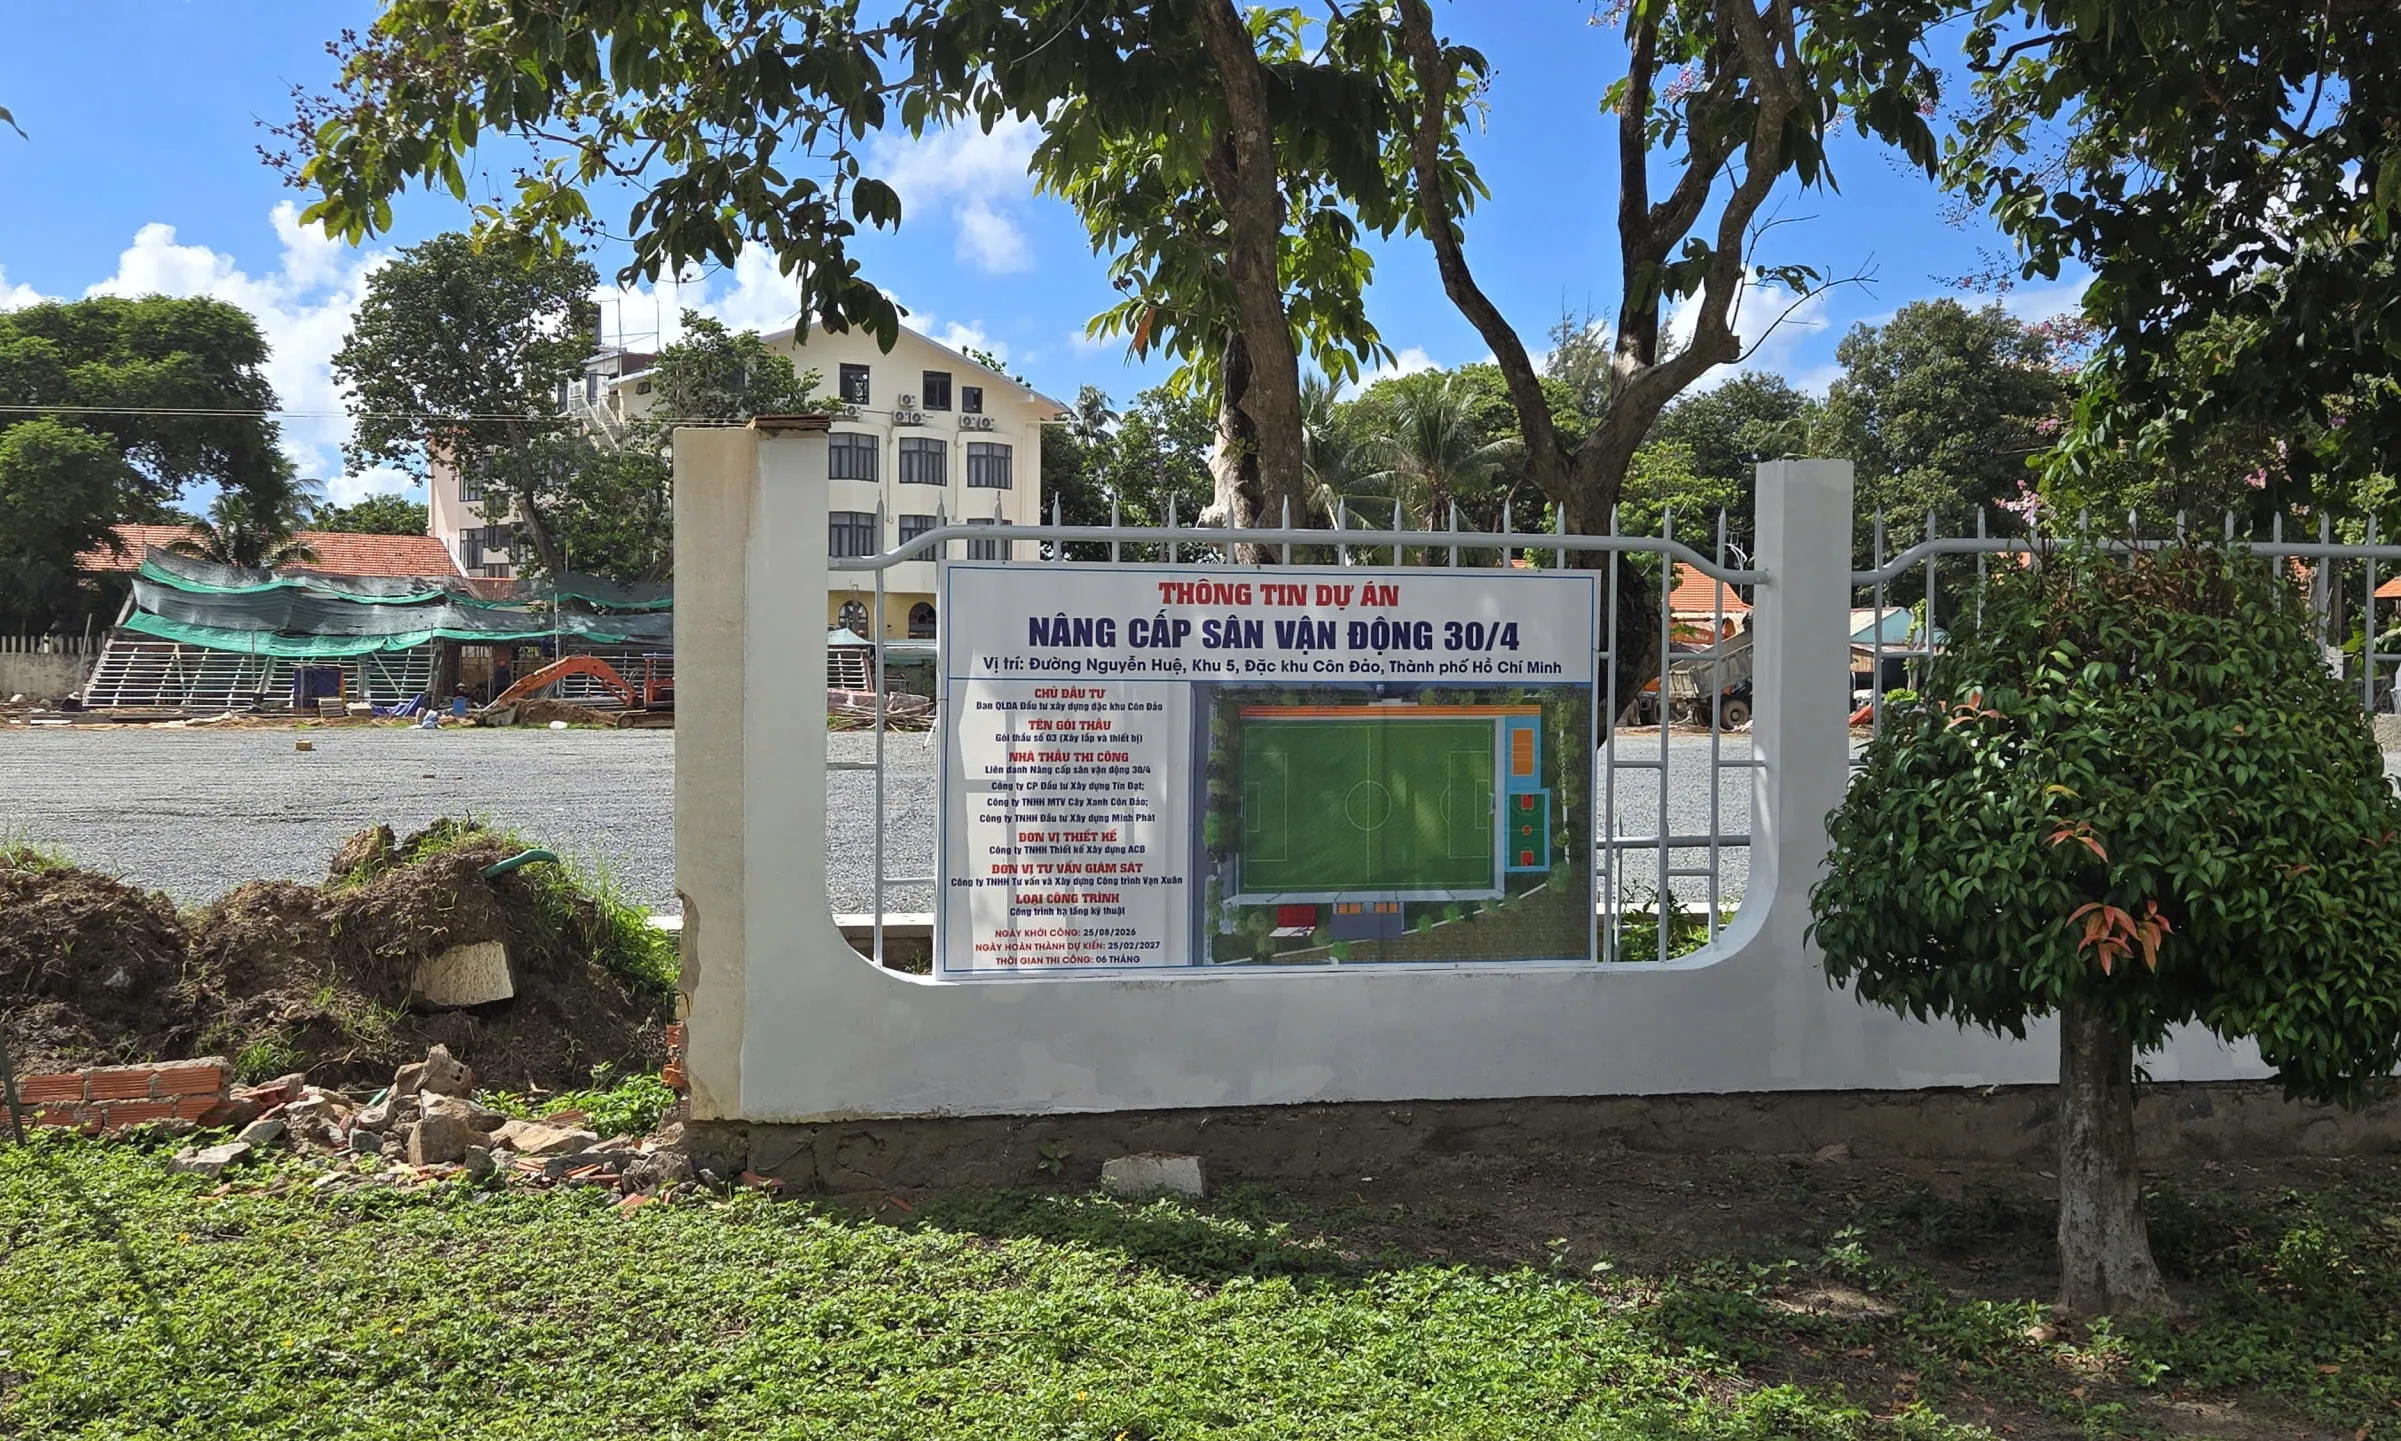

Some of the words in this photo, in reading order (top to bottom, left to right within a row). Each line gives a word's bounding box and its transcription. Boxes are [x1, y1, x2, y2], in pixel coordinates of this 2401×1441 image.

[1158, 578, 1251, 605] THÔNG
[1260, 583, 1307, 606] TIN
[1316, 584, 1354, 610] DỰ
[1360, 581, 1399, 606] ÁN
[1029, 612, 1116, 648] NÂNG
[1129, 609, 1191, 648] CẤP
[1202, 614, 1263, 648] SÂN
[1275, 615, 1336, 655] VẬN
[1348, 616, 1433, 655] ĐỘNG
[1444, 621, 1519, 650] 30/4
[984, 656, 998, 673] Vị
[1004, 657, 1024, 670] trí:
[1030, 657, 1081, 673] Đường
[1087, 655, 1146, 673] Nguyễn
[1152, 658, 1186, 675] Huệ,
[1192, 659, 1221, 672] Khu
[1226, 659, 1239, 674] 5,
[1245, 659, 1276, 676] Đặc
[1281, 659, 1307, 672] khu
[1314, 659, 1344, 673] Côn
[1350, 658, 1384, 675] Đảo,
[1390, 660, 1434, 673] Thành
[1440, 658, 1468, 676] phố
[1473, 657, 1492, 673] Hồ
[1498, 659, 1522, 673] Chí
[1527, 661, 1561, 674] Minh
[1035, 686, 1058, 698] CHỦ
[1089, 688, 1106, 698] TƯ
[977, 702, 992, 710] Ban
[996, 702, 1018, 711] QLDA
[1040, 702, 1048, 710] tư
[1050, 702, 1065, 712] xây
[1068, 702, 1088, 712] dựng
[1092, 702, 1107, 713] đặc
[1110, 702, 1125, 711] khu
[1128, 702, 1144, 711] Côn
[1147, 702, 1162, 711] Đảo
[1028, 718, 1052, 730] TÊN
[1034, 732, 1044, 742] số
[1047, 734, 1056, 742] 03
[1059, 733, 1078, 744] (Xây
[1098, 733, 1107, 742] và
[1009, 749, 1035, 761] NHÀ
[1075, 752, 1094, 762] THI
[1097, 751, 1129, 762] CÔNG
[985, 765, 1004, 774] Liên
[1007, 766, 1027, 774] danh
[1030, 765, 1052, 775] Nâng
[1055, 763, 1070, 776] cấp
[1073, 765, 1088, 774] sân
[1091, 765, 1106, 775] vận
[1109, 765, 1129, 776] động
[1132, 766, 1150, 774] 30/4
[991, 781, 1013, 791] Công
[1016, 782, 1024, 791] ty
[1027, 782, 1038, 790] CP
[1060, 782, 1068, 790] tư
[1070, 781, 1087, 791] Xây
[1089, 782, 1109, 791] dựng
[1112, 781, 1125, 790] Tín
[1127, 782, 1144, 792] Đạt;
[987, 797, 1009, 807] Công
[1012, 798, 1019, 807] ty
[1022, 798, 1045, 806] TNHH
[1048, 798, 1065, 806] MTV
[1068, 797, 1084, 807] Cây
[1086, 798, 1108, 806] Xanh
[1111, 797, 1126, 806] Côn
[980, 813, 1002, 824] Công
[1004, 814, 1012, 823] ty
[1014, 814, 1038, 822] TNHH
[1059, 814, 1067, 822] tư
[1070, 814, 1086, 824] Xây
[1088, 814, 1109, 824] dựng
[1112, 814, 1133, 822] Minh
[1136, 813, 1155, 822] Phát
[1048, 832, 1060, 844] VỊ
[1064, 828, 1098, 842] THIẾT
[1101, 828, 1117, 842] KẾ
[990, 846, 1011, 855] Công
[1014, 847, 1022, 855] ty
[1024, 846, 1047, 854] TNHH
[1086, 845, 1102, 855] Xây
[1105, 846, 1125, 855] dựng
[1021, 864, 1033, 876] VỊ
[1037, 863, 1054, 874] TƯ
[1057, 859, 1081, 874] VẤN
[1085, 861, 1117, 873] GIÁM
[1120, 861, 1143, 873] SÁT
[951, 877, 973, 887] Công
[976, 878, 983, 887] ty
[986, 878, 1009, 886] TNHH
[1012, 877, 1022, 886] Tư
[1025, 875, 1040, 886] vấn
[1043, 877, 1052, 886] và
[1055, 876, 1071, 887] Xây
[1073, 877, 1094, 887] dựng
[1096, 876, 1118, 887] Công
[1121, 876, 1140, 885] trình
[1143, 877, 1159, 886] Vạn
[1161, 876, 1183, 885] Xuân
[1016, 893, 1043, 906] LOẠI
[1047, 891, 1078, 903] CÔNG
[1082, 891, 1119, 903] TRÌNH
[1010, 907, 1031, 917] Công
[1034, 907, 1054, 916] trình
[1056, 908, 1067, 917] hạ
[1104, 906, 1125, 916] thuật
[995, 928, 1022, 938] NGÀY
[1050, 928, 1081, 937] CÔNG:
[1083, 928, 1136, 937] 25/08/2026
[976, 942, 1002, 952] NGÀY
[1005, 941, 1032, 951] HOÀN
[1035, 941, 1065, 951] THÀNH
[1067, 941, 1081, 952] DỰ
[1083, 939, 1105, 950] KIẾN:
[1108, 941, 1160, 950] 25/02/2027
[1020, 956, 1044, 965] GIAN
[1046, 956, 1060, 964] THI
[1063, 955, 1094, 964] CÔNG:
[1096, 956, 1107, 964] 06
[1109, 954, 1140, 964] THÁNG
